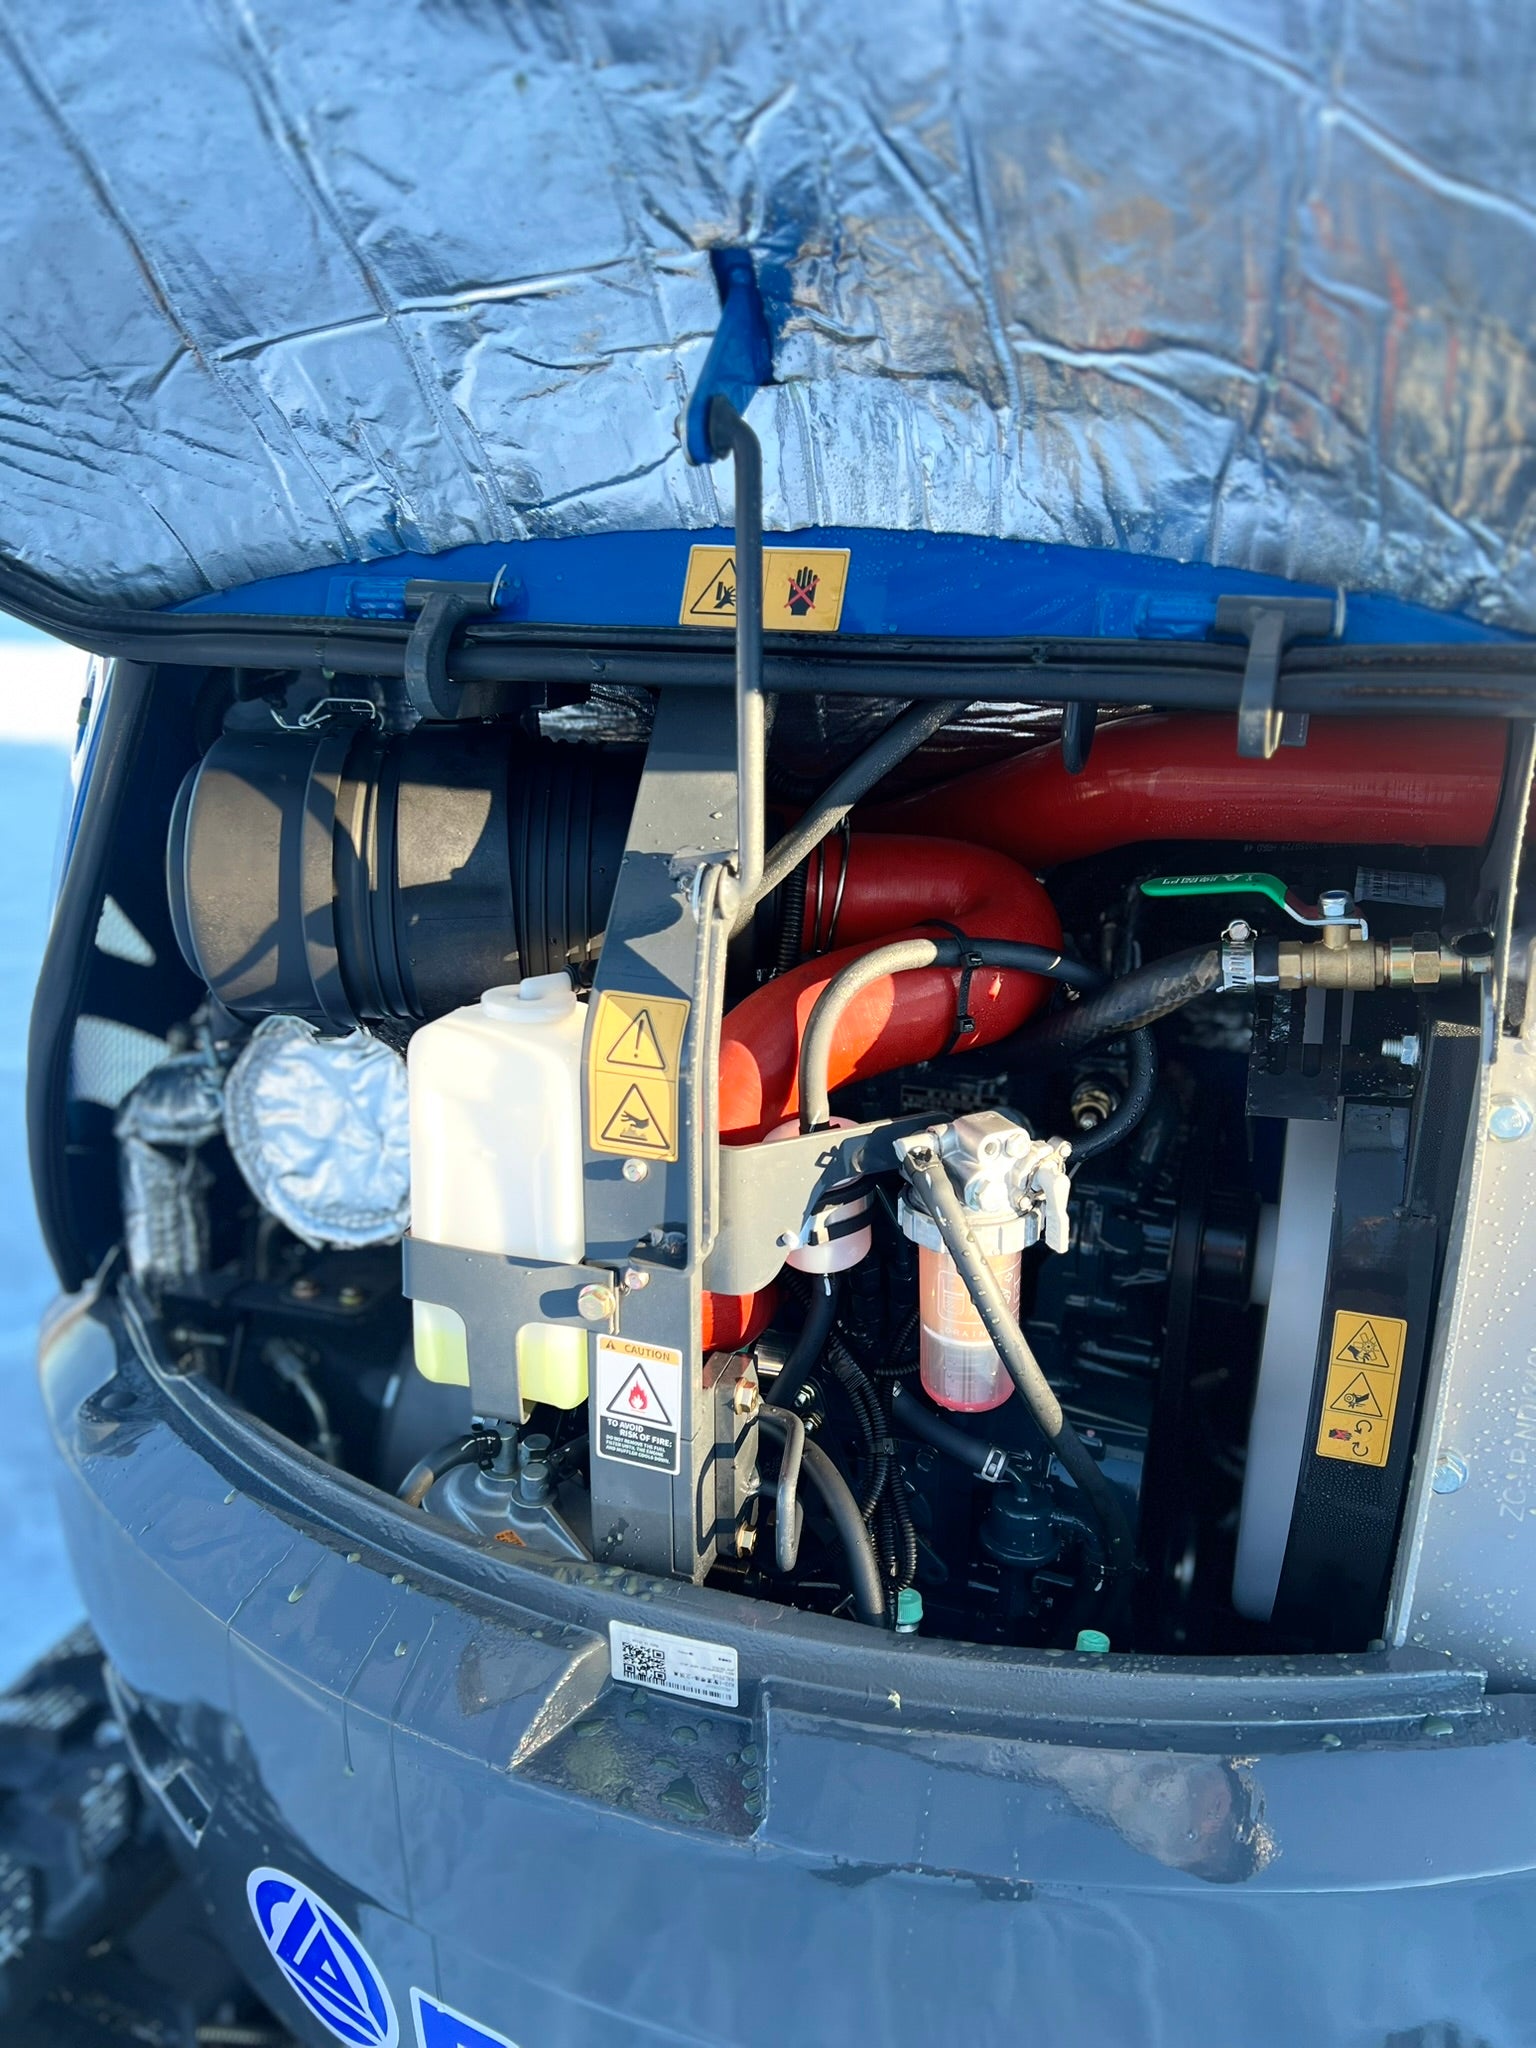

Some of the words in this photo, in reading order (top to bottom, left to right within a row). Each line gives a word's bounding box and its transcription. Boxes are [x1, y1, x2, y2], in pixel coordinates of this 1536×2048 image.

[625, 1344, 670, 1361] CAUTION
[607, 1418, 618, 1427] TO
[619, 1422, 644, 1432] AVOID
[620, 1429, 638, 1439] RISK
[640, 1434, 650, 1442] OF
[624, 1438, 642, 1447] REMOVE
[616, 1447, 637, 1455] MUFFLER
[647, 1449, 664, 1457] ENGINE
